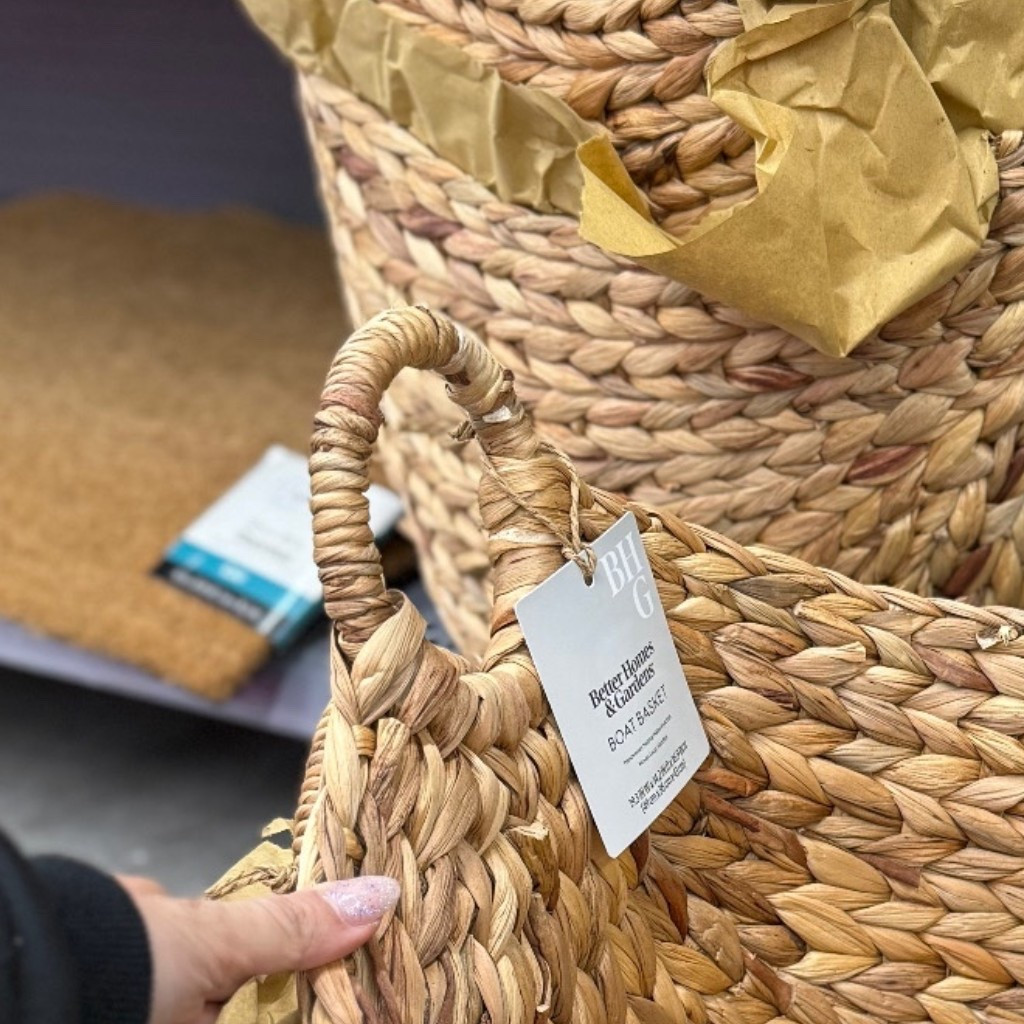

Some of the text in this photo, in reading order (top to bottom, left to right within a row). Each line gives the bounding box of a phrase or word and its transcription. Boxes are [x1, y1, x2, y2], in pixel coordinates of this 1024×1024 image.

[588, 640, 655, 709] Better Homes
[607, 717, 637, 752] BOAT
[635, 684, 668, 726] BASKET
